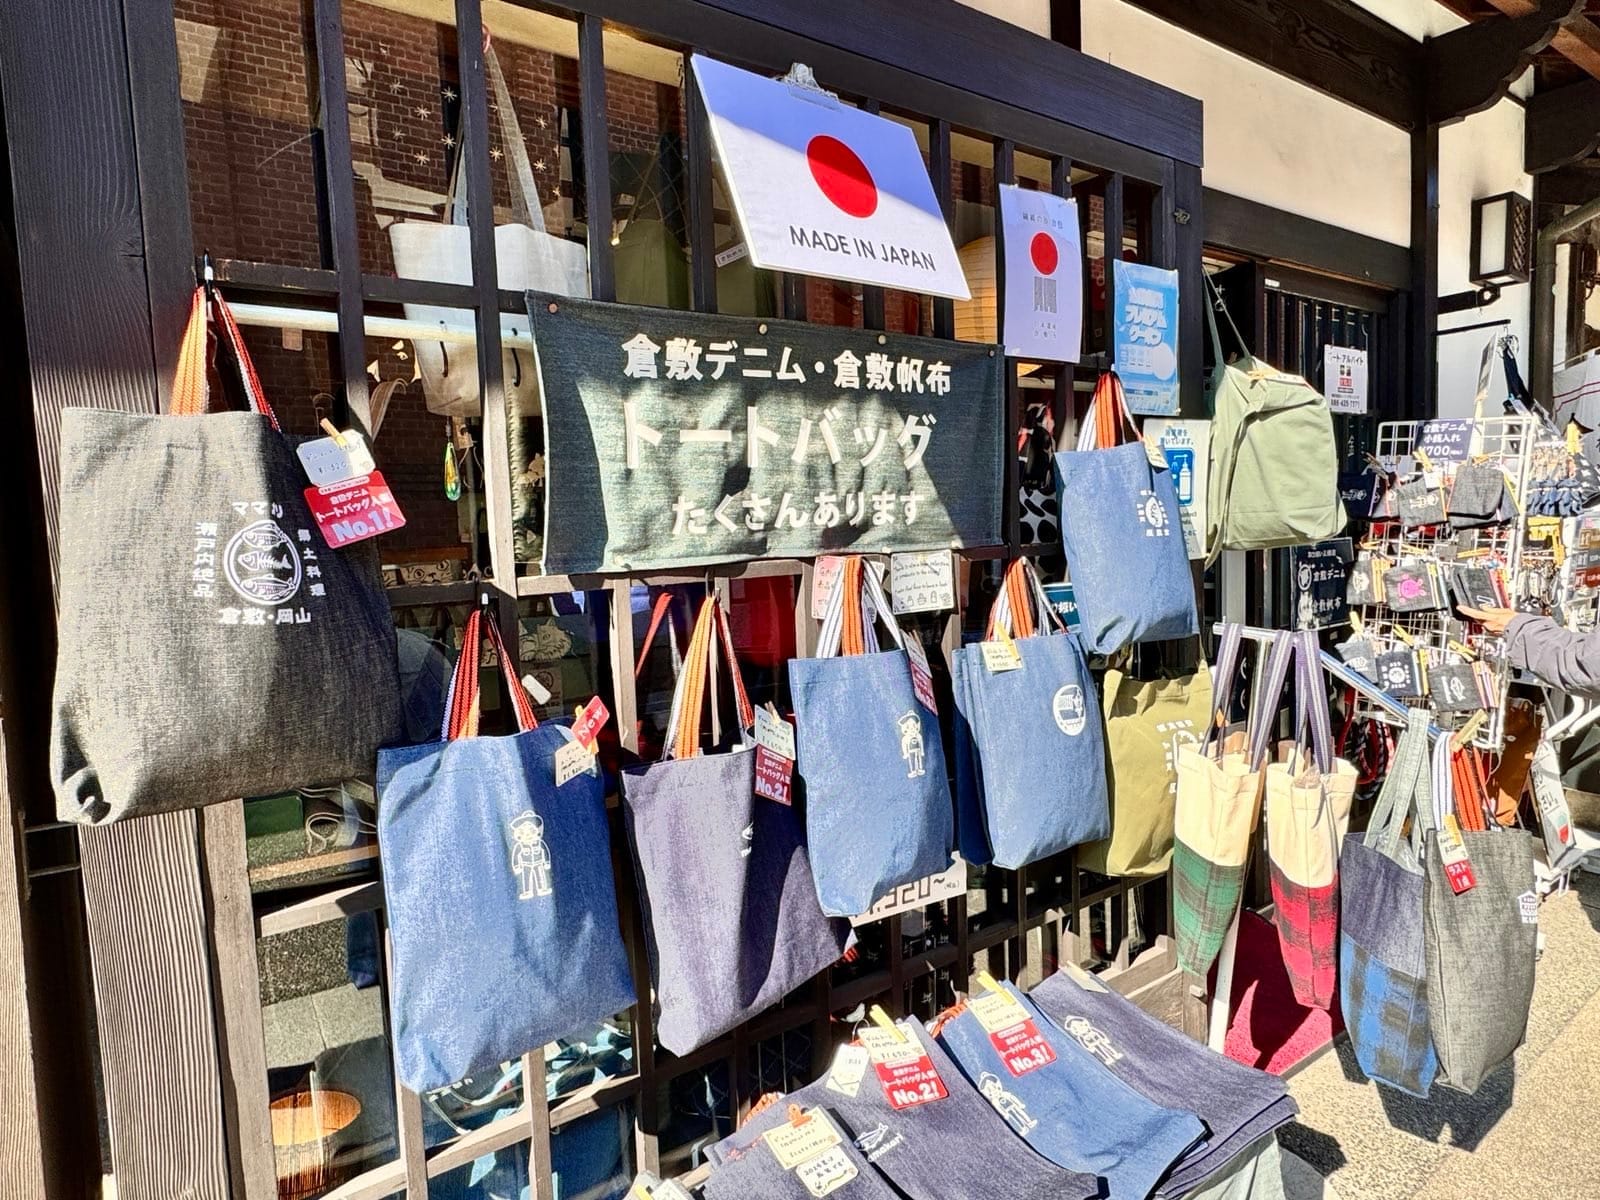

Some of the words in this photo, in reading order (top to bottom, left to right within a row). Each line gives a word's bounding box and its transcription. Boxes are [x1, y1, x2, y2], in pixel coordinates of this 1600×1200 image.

[789, 225, 852, 256] MADE
[853, 238, 877, 260] IN
[880, 244, 937, 272] JAPAN
[621, 332, 952, 397] 倉敷デニム・倉敷帆布
[624, 399, 937, 470] トートバッグ
[331, 507, 395, 543] No.1!
[672, 489, 927, 536] たくさんあります
[192, 522, 219, 598] 瀬戸内絶品
[218, 607, 312, 625] 倉敷・岡山
[577, 705, 604, 741] New
[755, 775, 788, 802] No.2!
[1009, 1045, 1051, 1074] No.3!
[892, 1081, 941, 1107] No.2!
